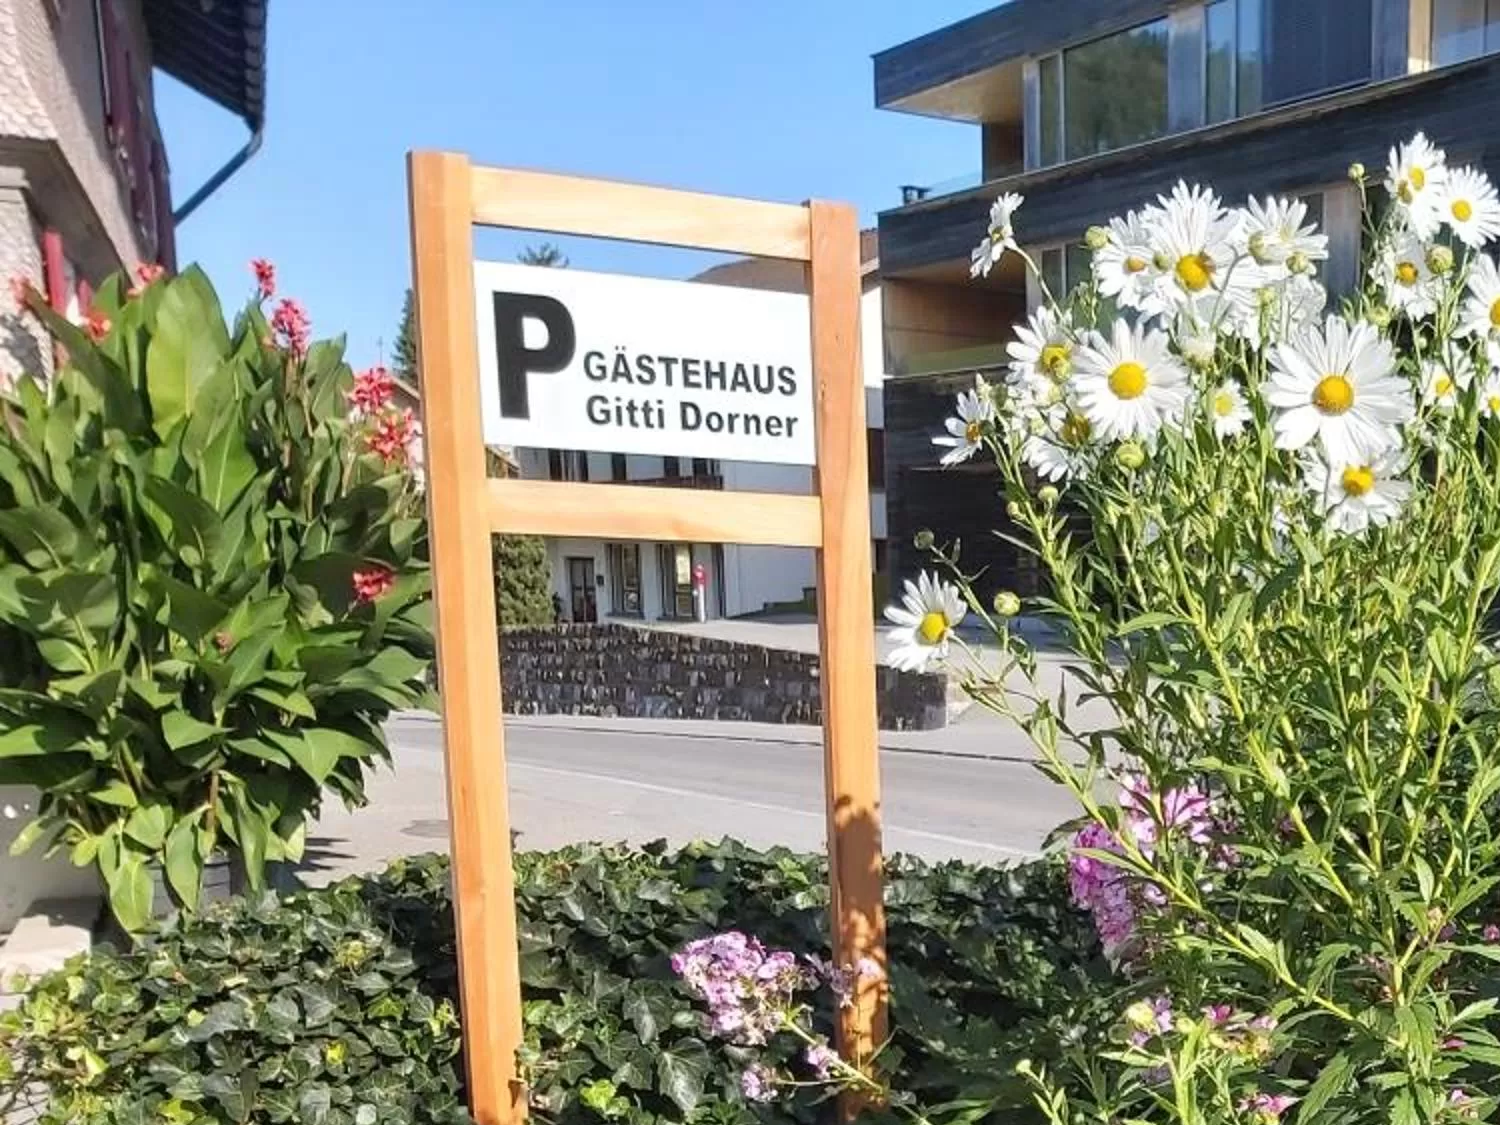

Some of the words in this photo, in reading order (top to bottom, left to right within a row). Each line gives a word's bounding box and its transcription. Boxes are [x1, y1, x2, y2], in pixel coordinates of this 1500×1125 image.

[493, 290, 576, 420] P
[583, 346, 798, 396] GÄSTEHAUS
[586, 395, 665, 429] Gitti
[680, 401, 799, 437] Dorner
